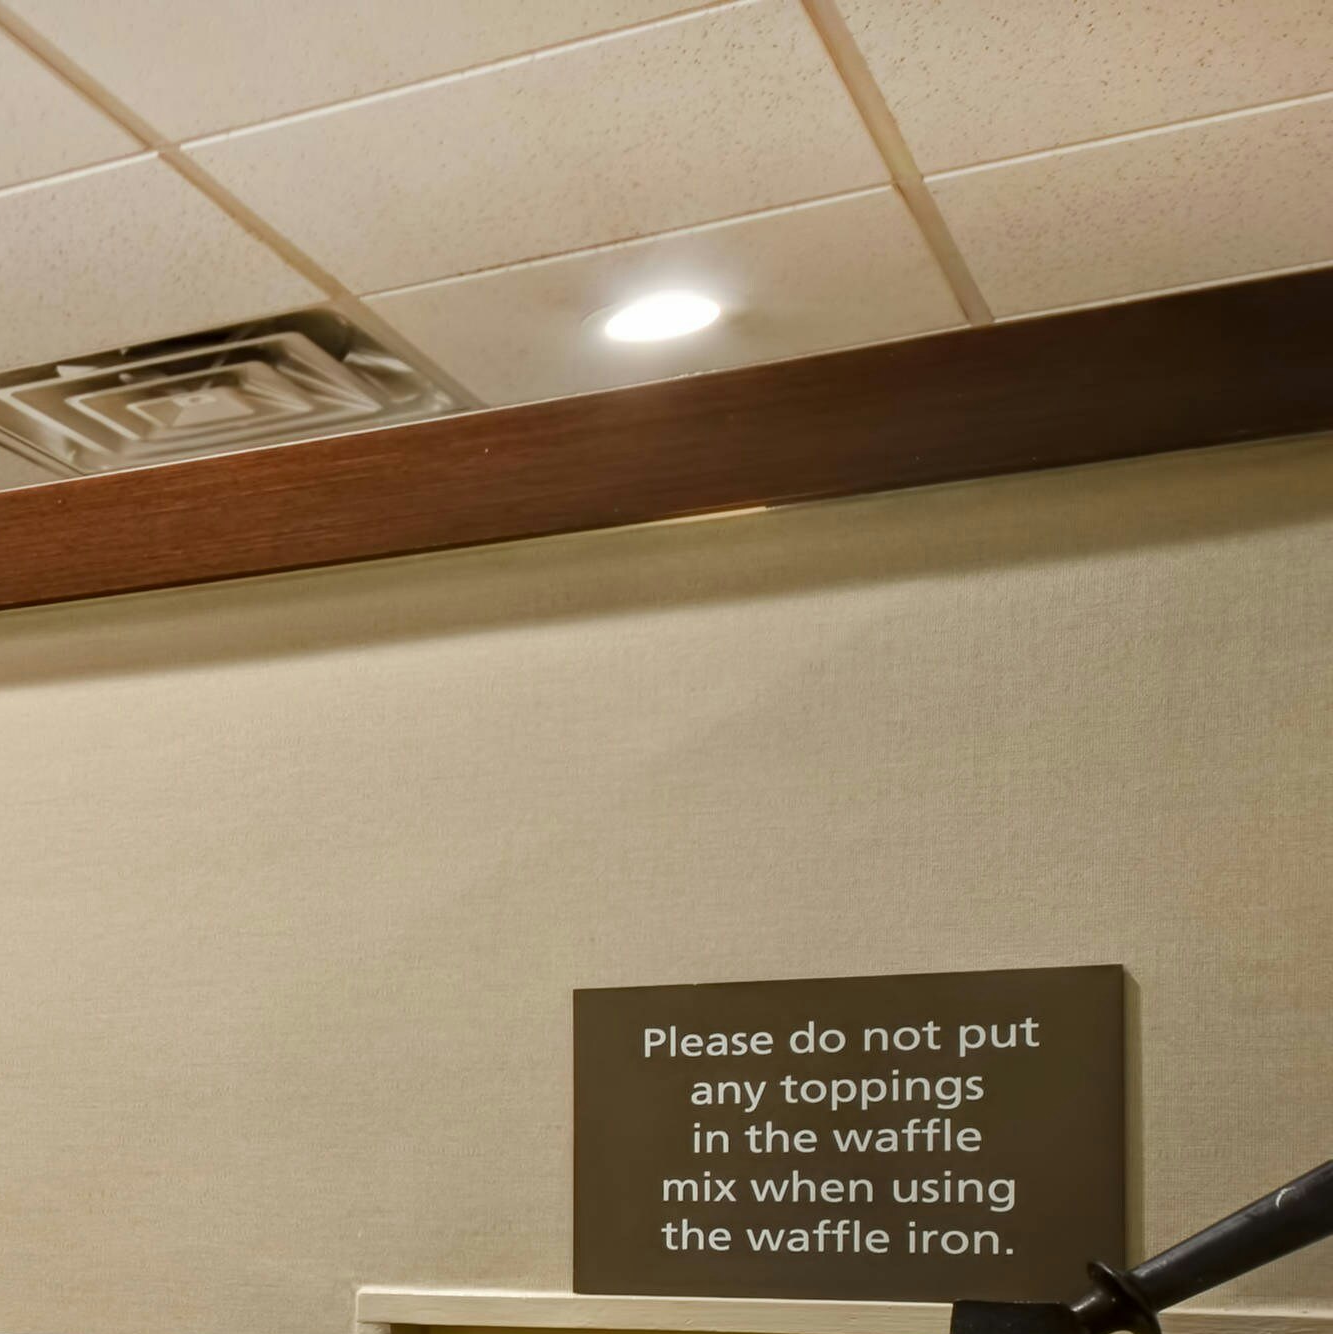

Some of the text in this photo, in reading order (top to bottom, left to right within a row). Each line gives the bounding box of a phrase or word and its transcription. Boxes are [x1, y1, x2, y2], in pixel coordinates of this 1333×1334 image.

[644, 1017, 1040, 1058] Please do not put
[691, 1069, 984, 1113] any toppings
[694, 1118, 982, 1153] in the waffle
[662, 1170, 1016, 1212] mix when using
[661, 1218, 1014, 1255] the waffle iron.
